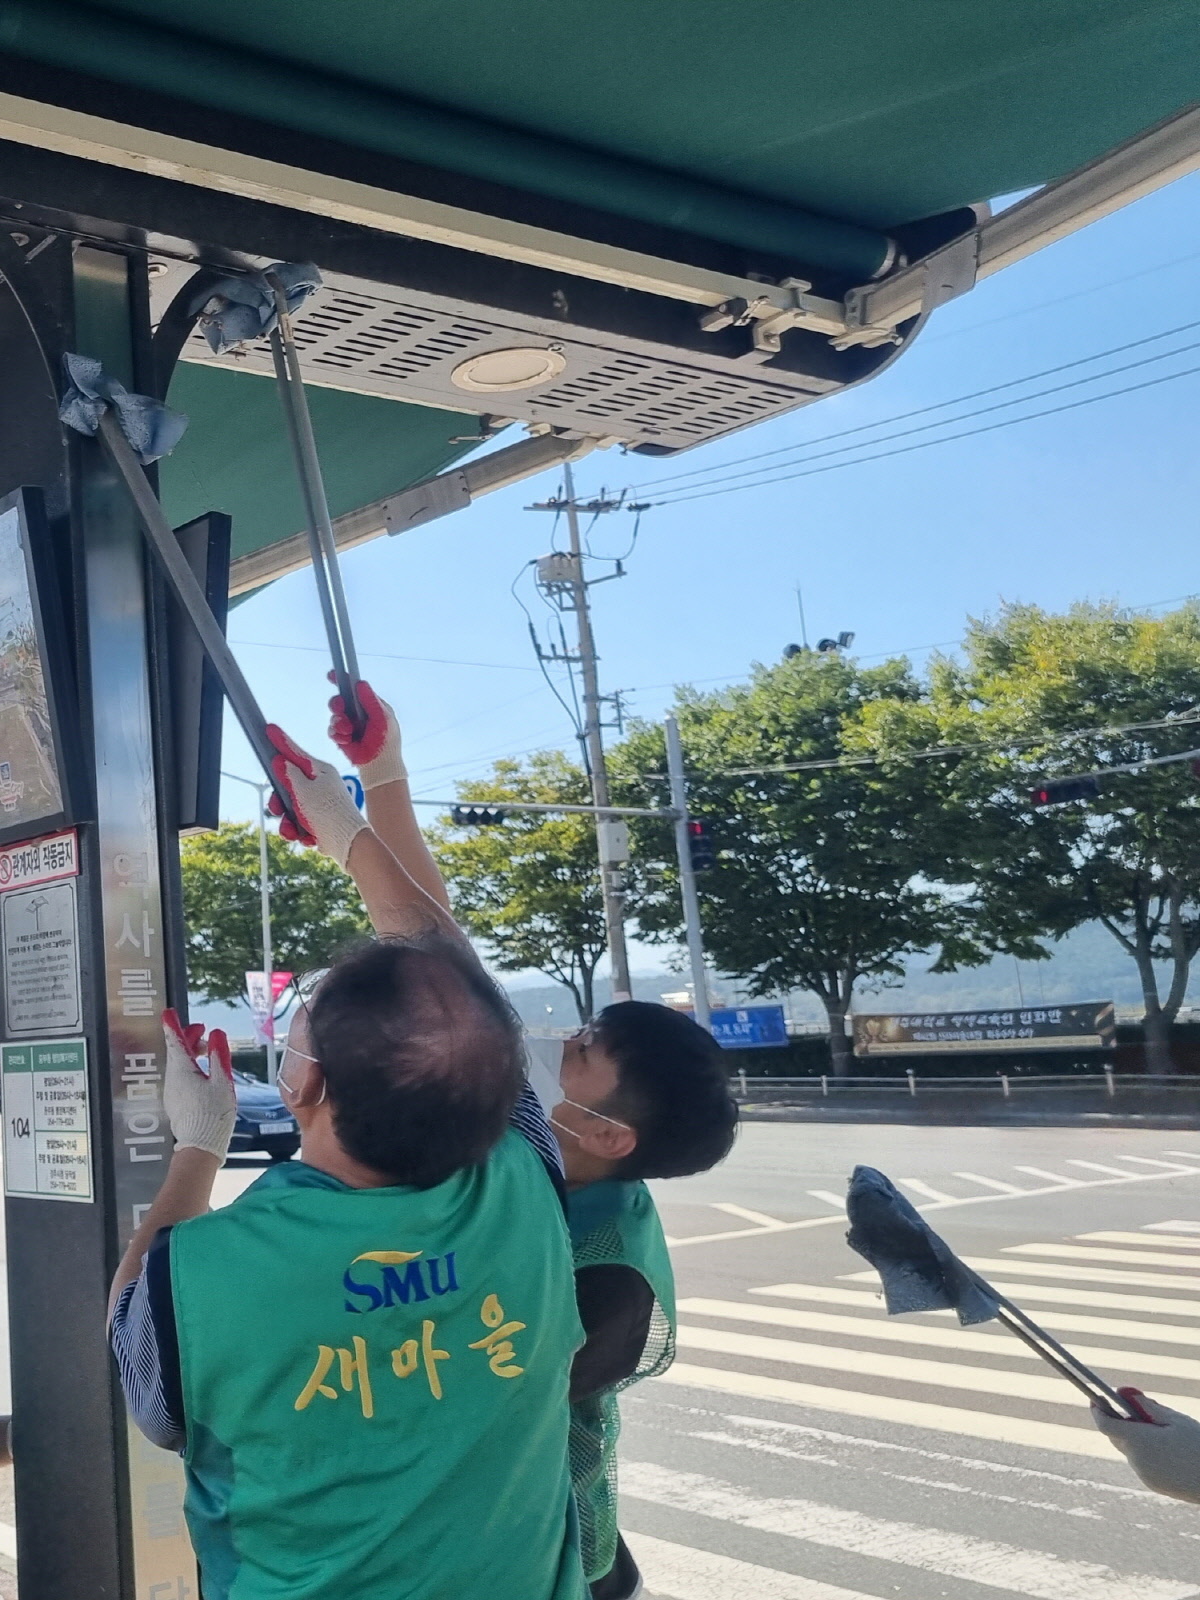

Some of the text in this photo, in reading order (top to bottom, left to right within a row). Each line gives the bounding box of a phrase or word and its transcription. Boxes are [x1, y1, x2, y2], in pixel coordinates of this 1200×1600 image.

[12, 839, 73, 878] 관계자외 작동금지
[113, 852, 157, 1017] 역사를
[11, 1117, 30, 1138] 104
[121, 1052, 165, 1163] 품은
[343, 1251, 460, 1314] SMU
[293, 1293, 527, 1419] 새마을
